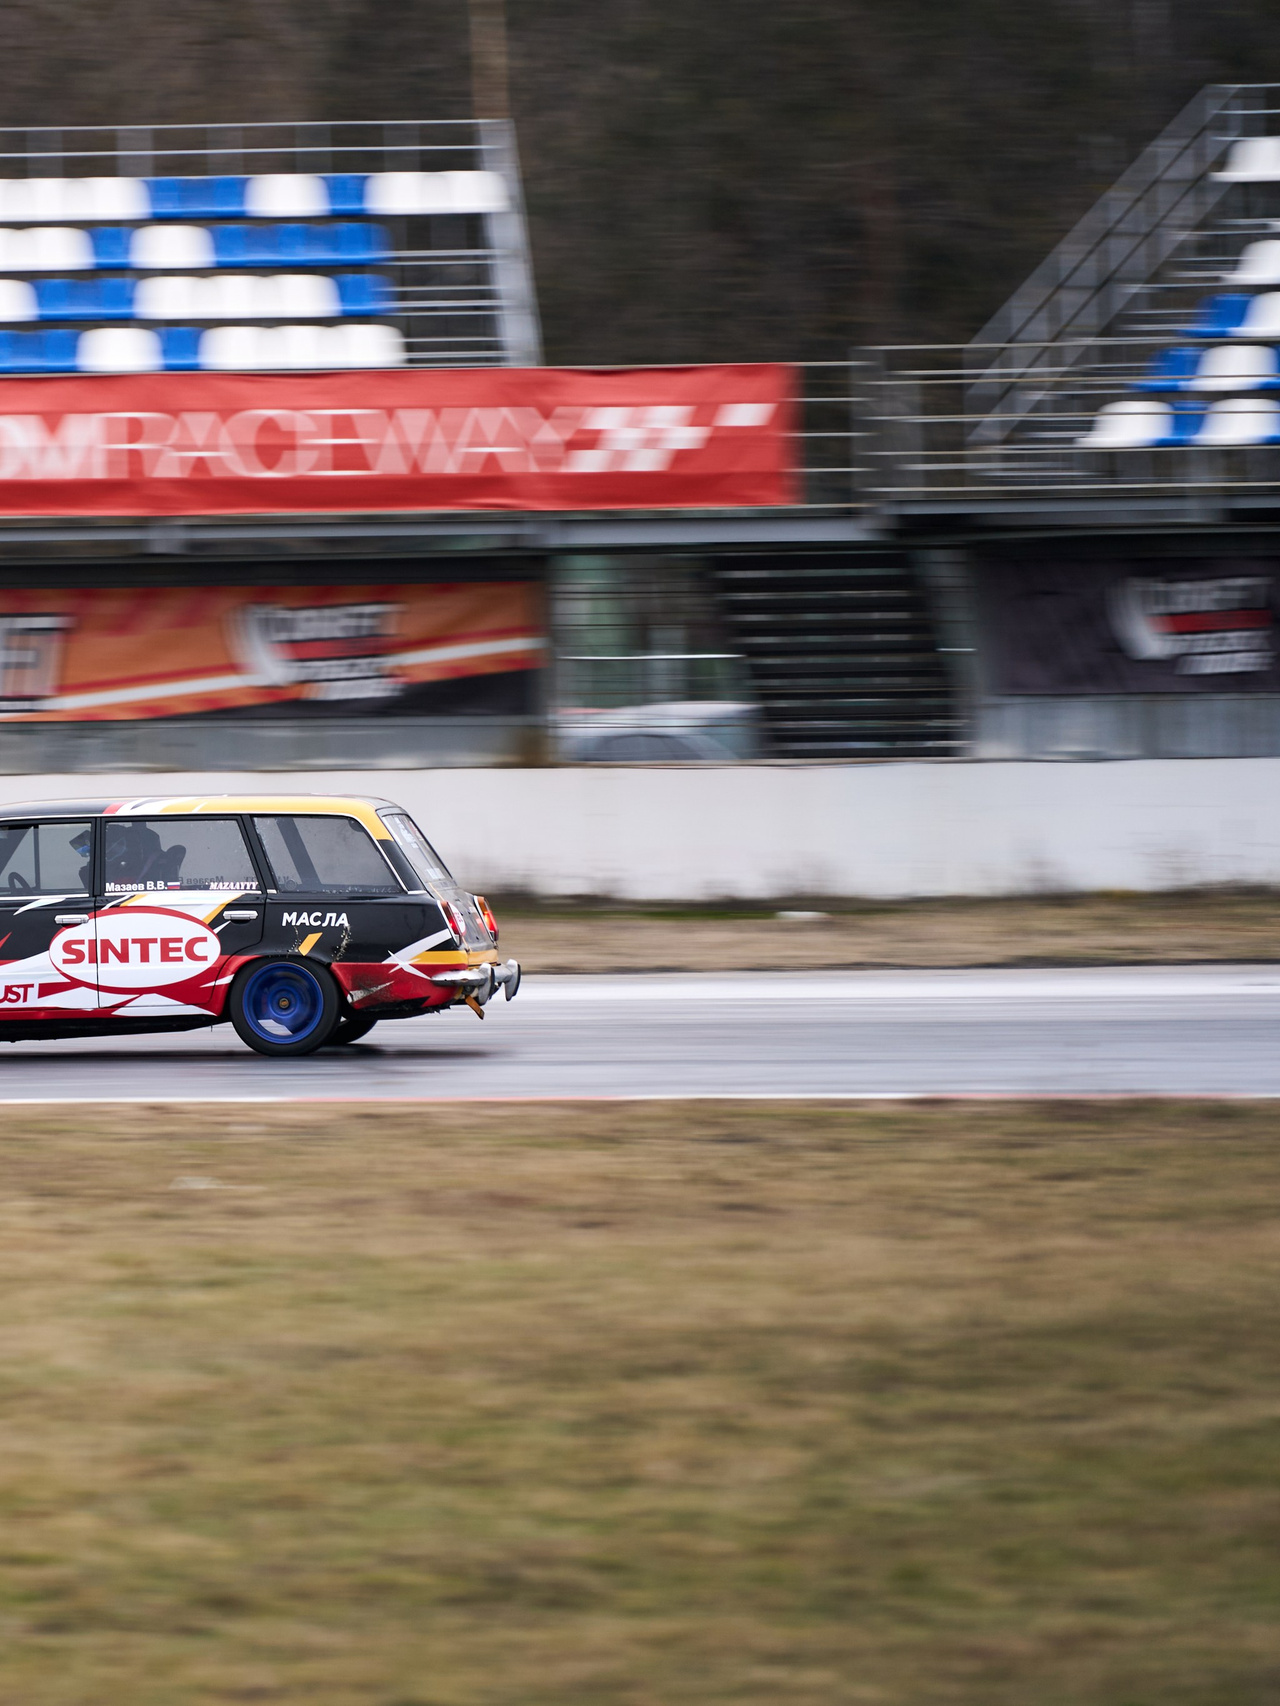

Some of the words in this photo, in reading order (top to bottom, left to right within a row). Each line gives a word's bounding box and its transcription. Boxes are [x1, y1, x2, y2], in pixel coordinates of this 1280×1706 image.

[105, 882, 145, 892] Мазаев
[281, 911, 350, 927] МАСЛА
[62, 936, 208, 965] SINTEC
